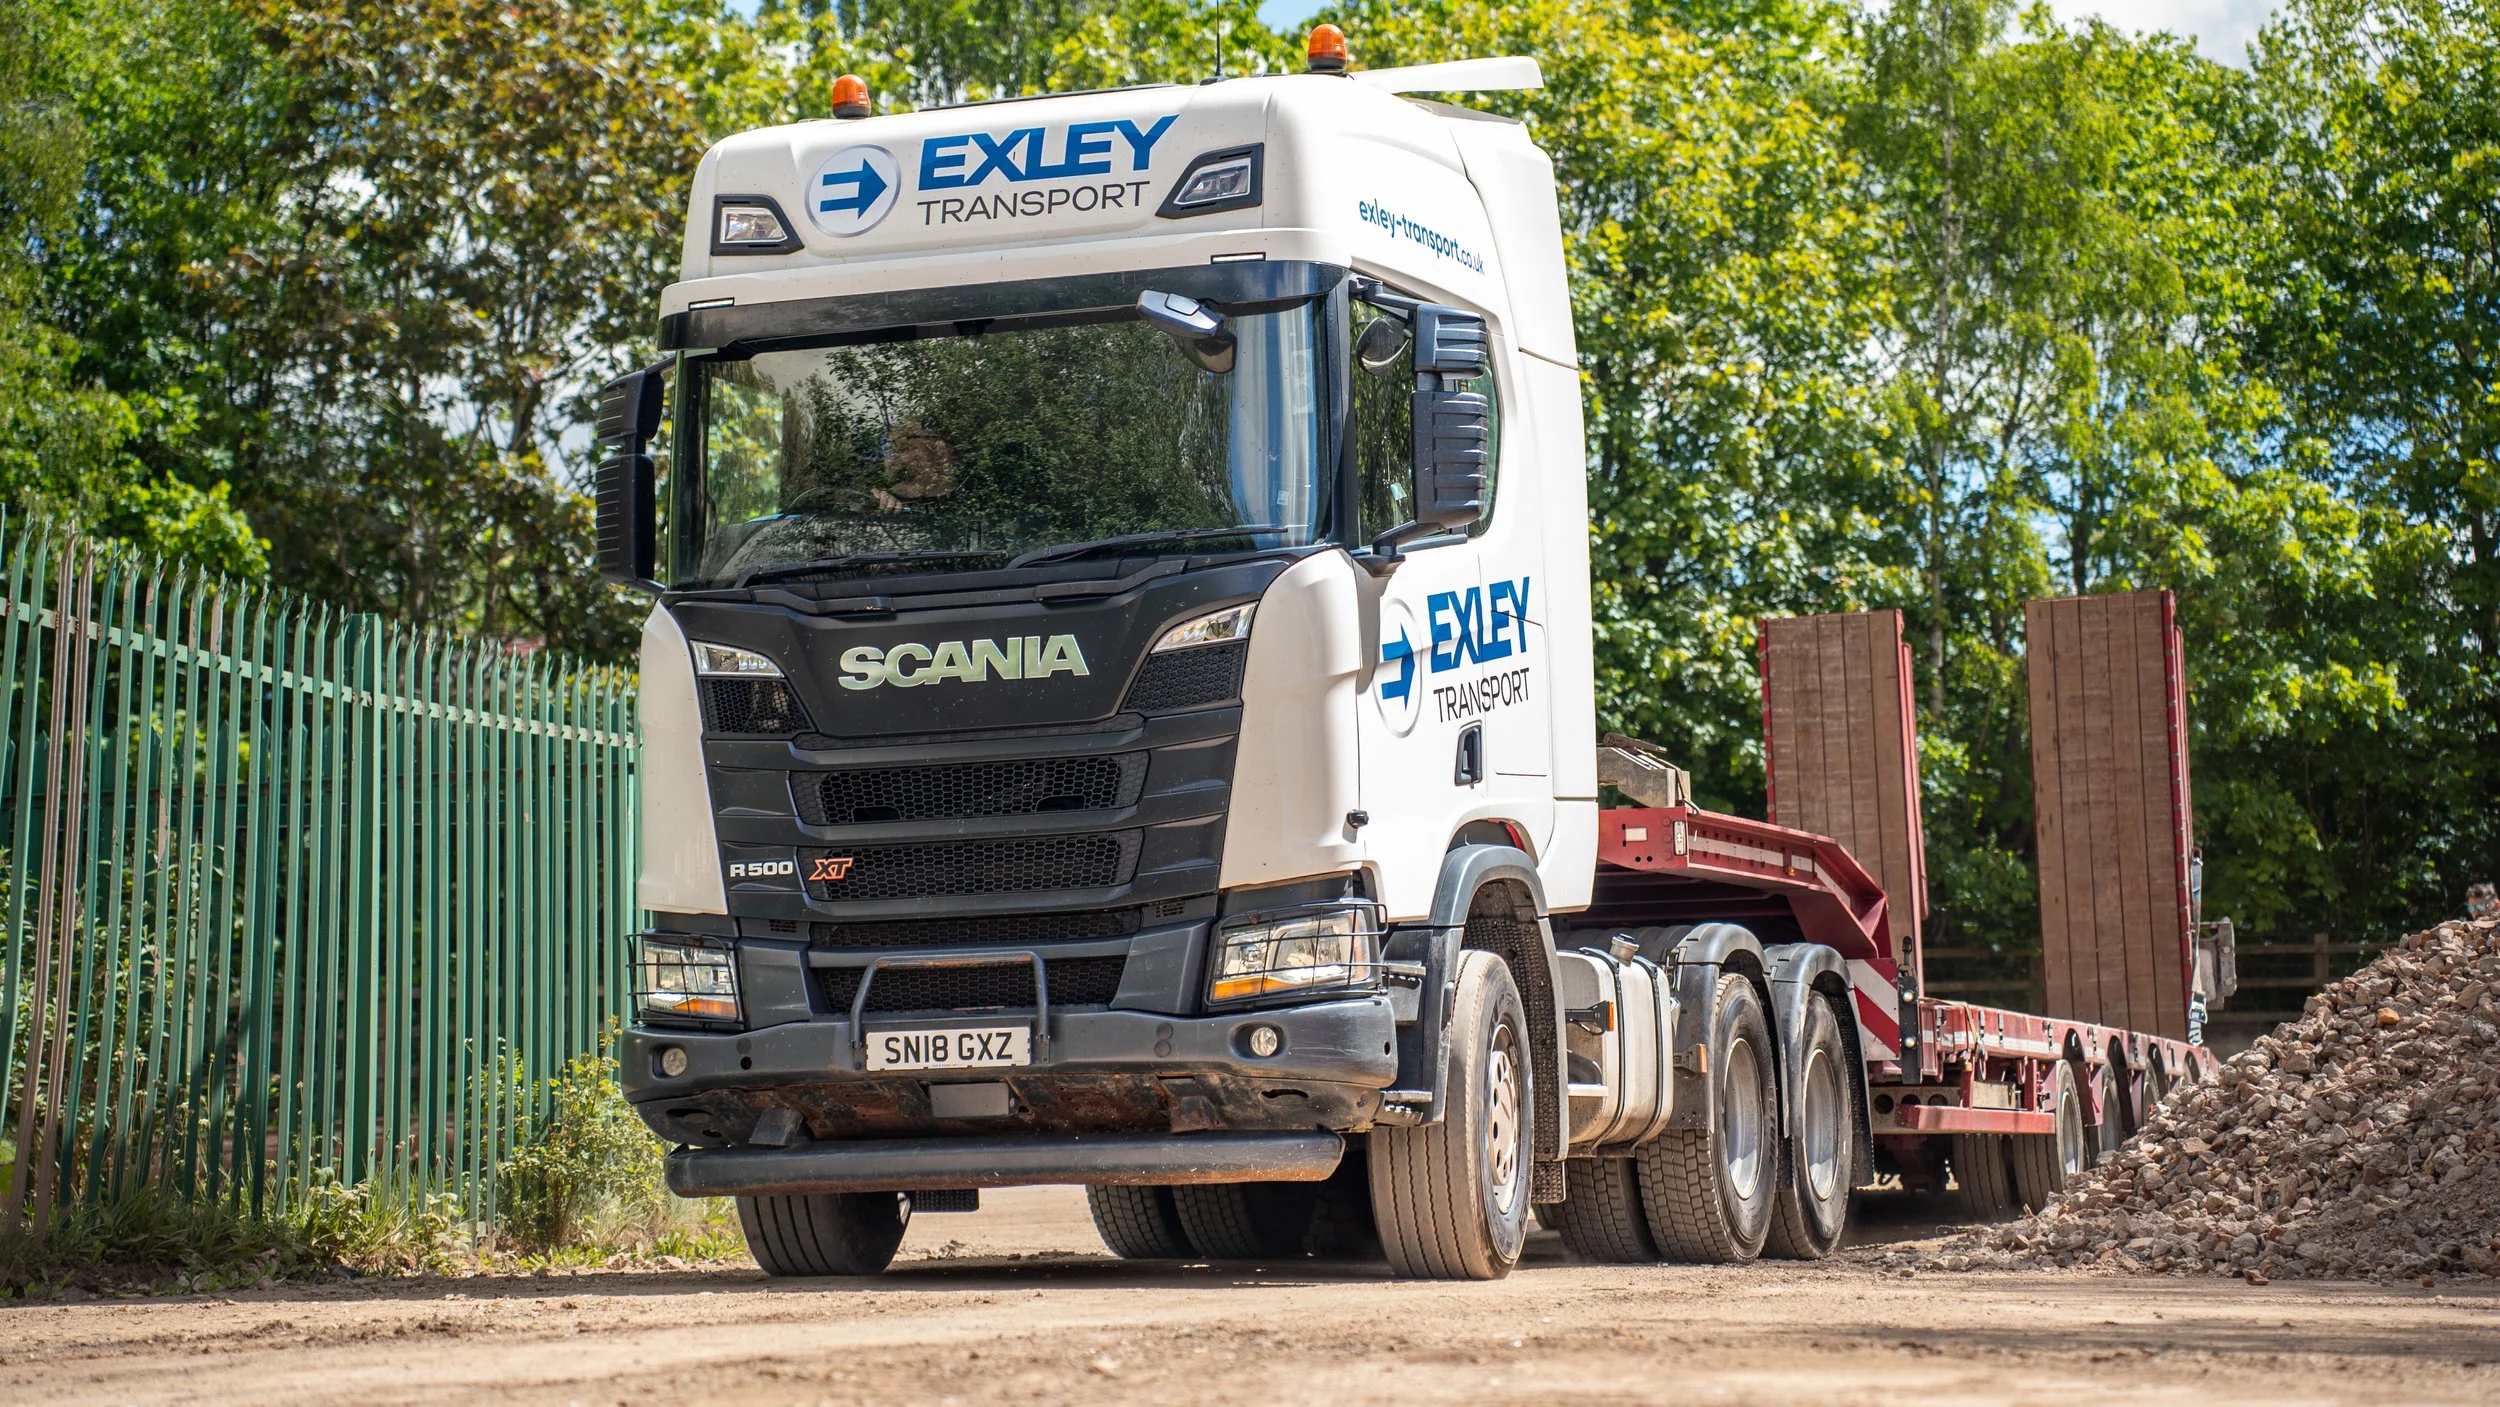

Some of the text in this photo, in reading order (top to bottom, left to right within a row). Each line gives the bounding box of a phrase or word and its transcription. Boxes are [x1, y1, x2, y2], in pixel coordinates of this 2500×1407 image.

[918, 114, 1180, 191] EXLEY
[917, 180, 1151, 225] TRANSPORT
[1358, 198, 1485, 275] exley-transport.co.uk
[1427, 576, 1530, 674] EXLEY
[838, 633, 1091, 691] SCANIA
[1433, 667, 1529, 723] TRANSPORT
[808, 857, 854, 881] XT
[884, 1031, 1013, 1064] SN18 GXZ
